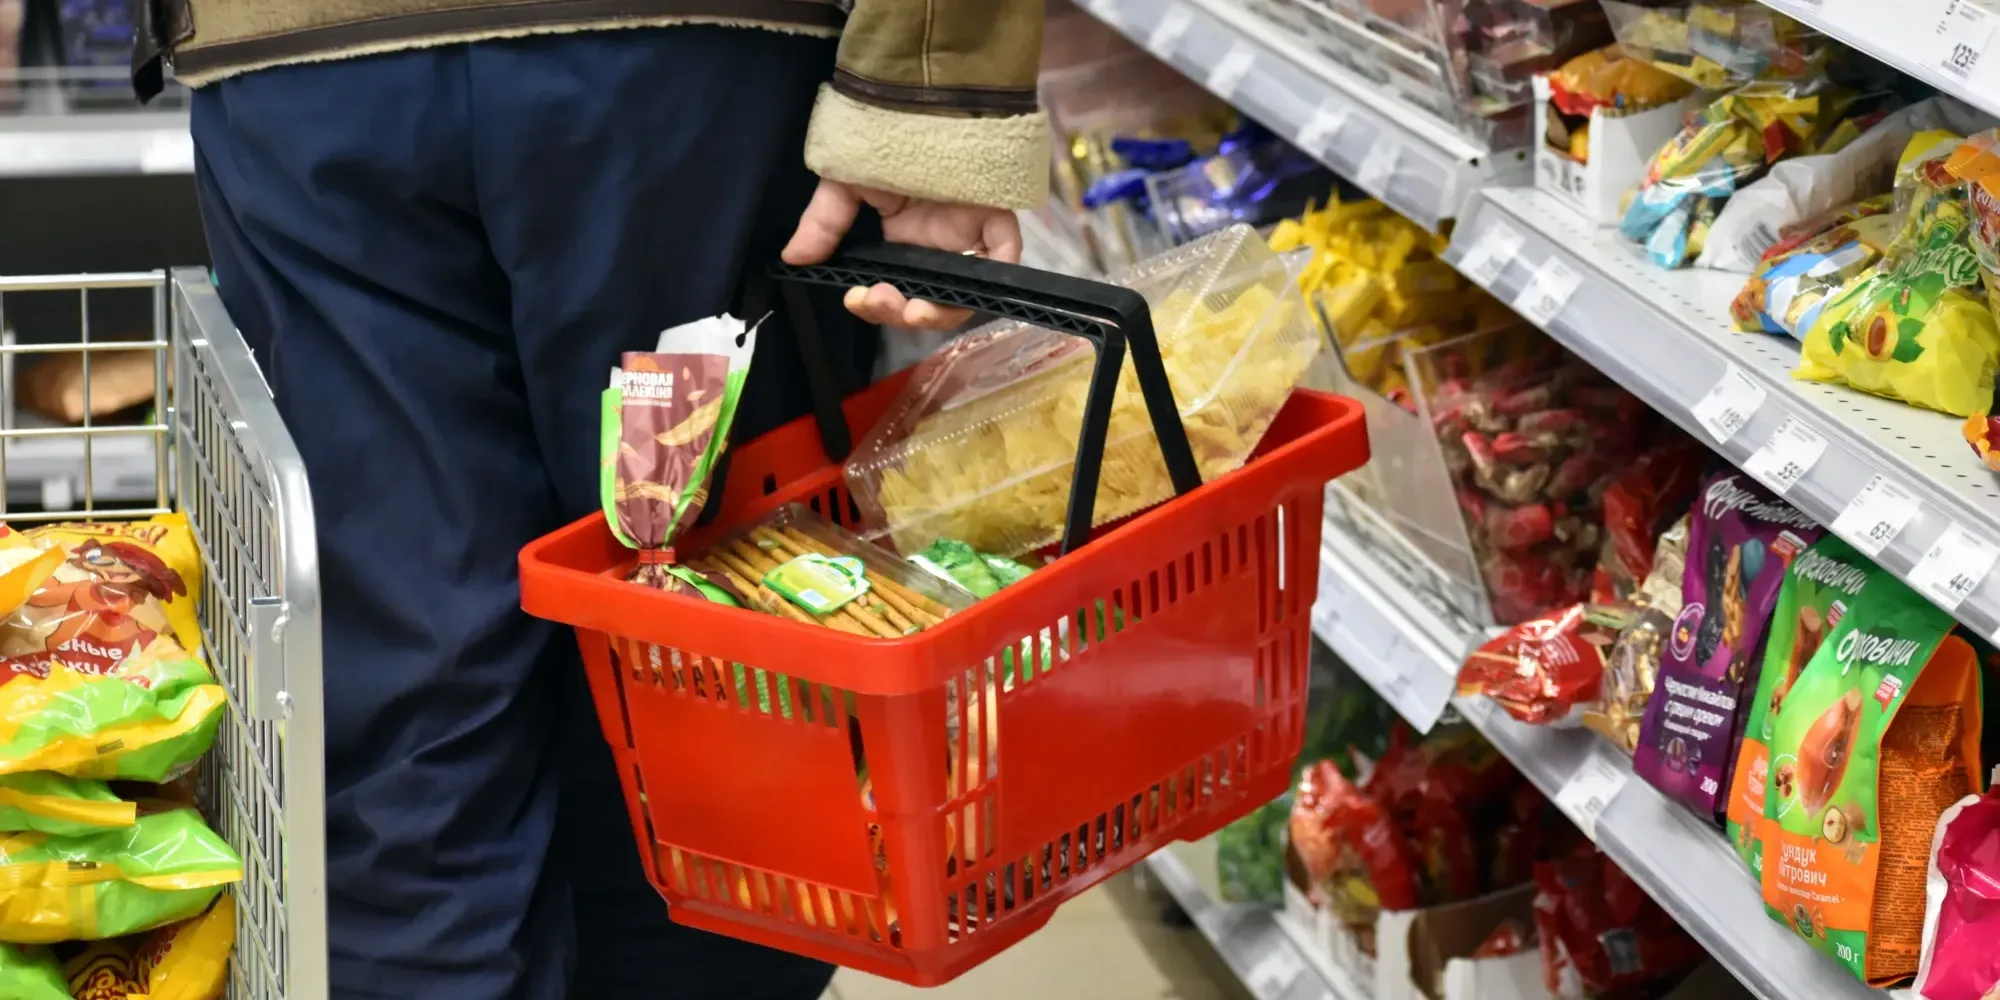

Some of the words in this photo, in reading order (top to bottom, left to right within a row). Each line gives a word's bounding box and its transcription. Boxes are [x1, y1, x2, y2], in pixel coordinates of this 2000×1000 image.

[1950, 42, 1973, 68] 123
[622, 372, 673, 385] ЕРНОВАЯ
[1870, 521, 1891, 540] 63
[1949, 573, 1970, 593] 44
[1781, 841, 1817, 867] ундук
[1835, 942, 1852, 962] 200
